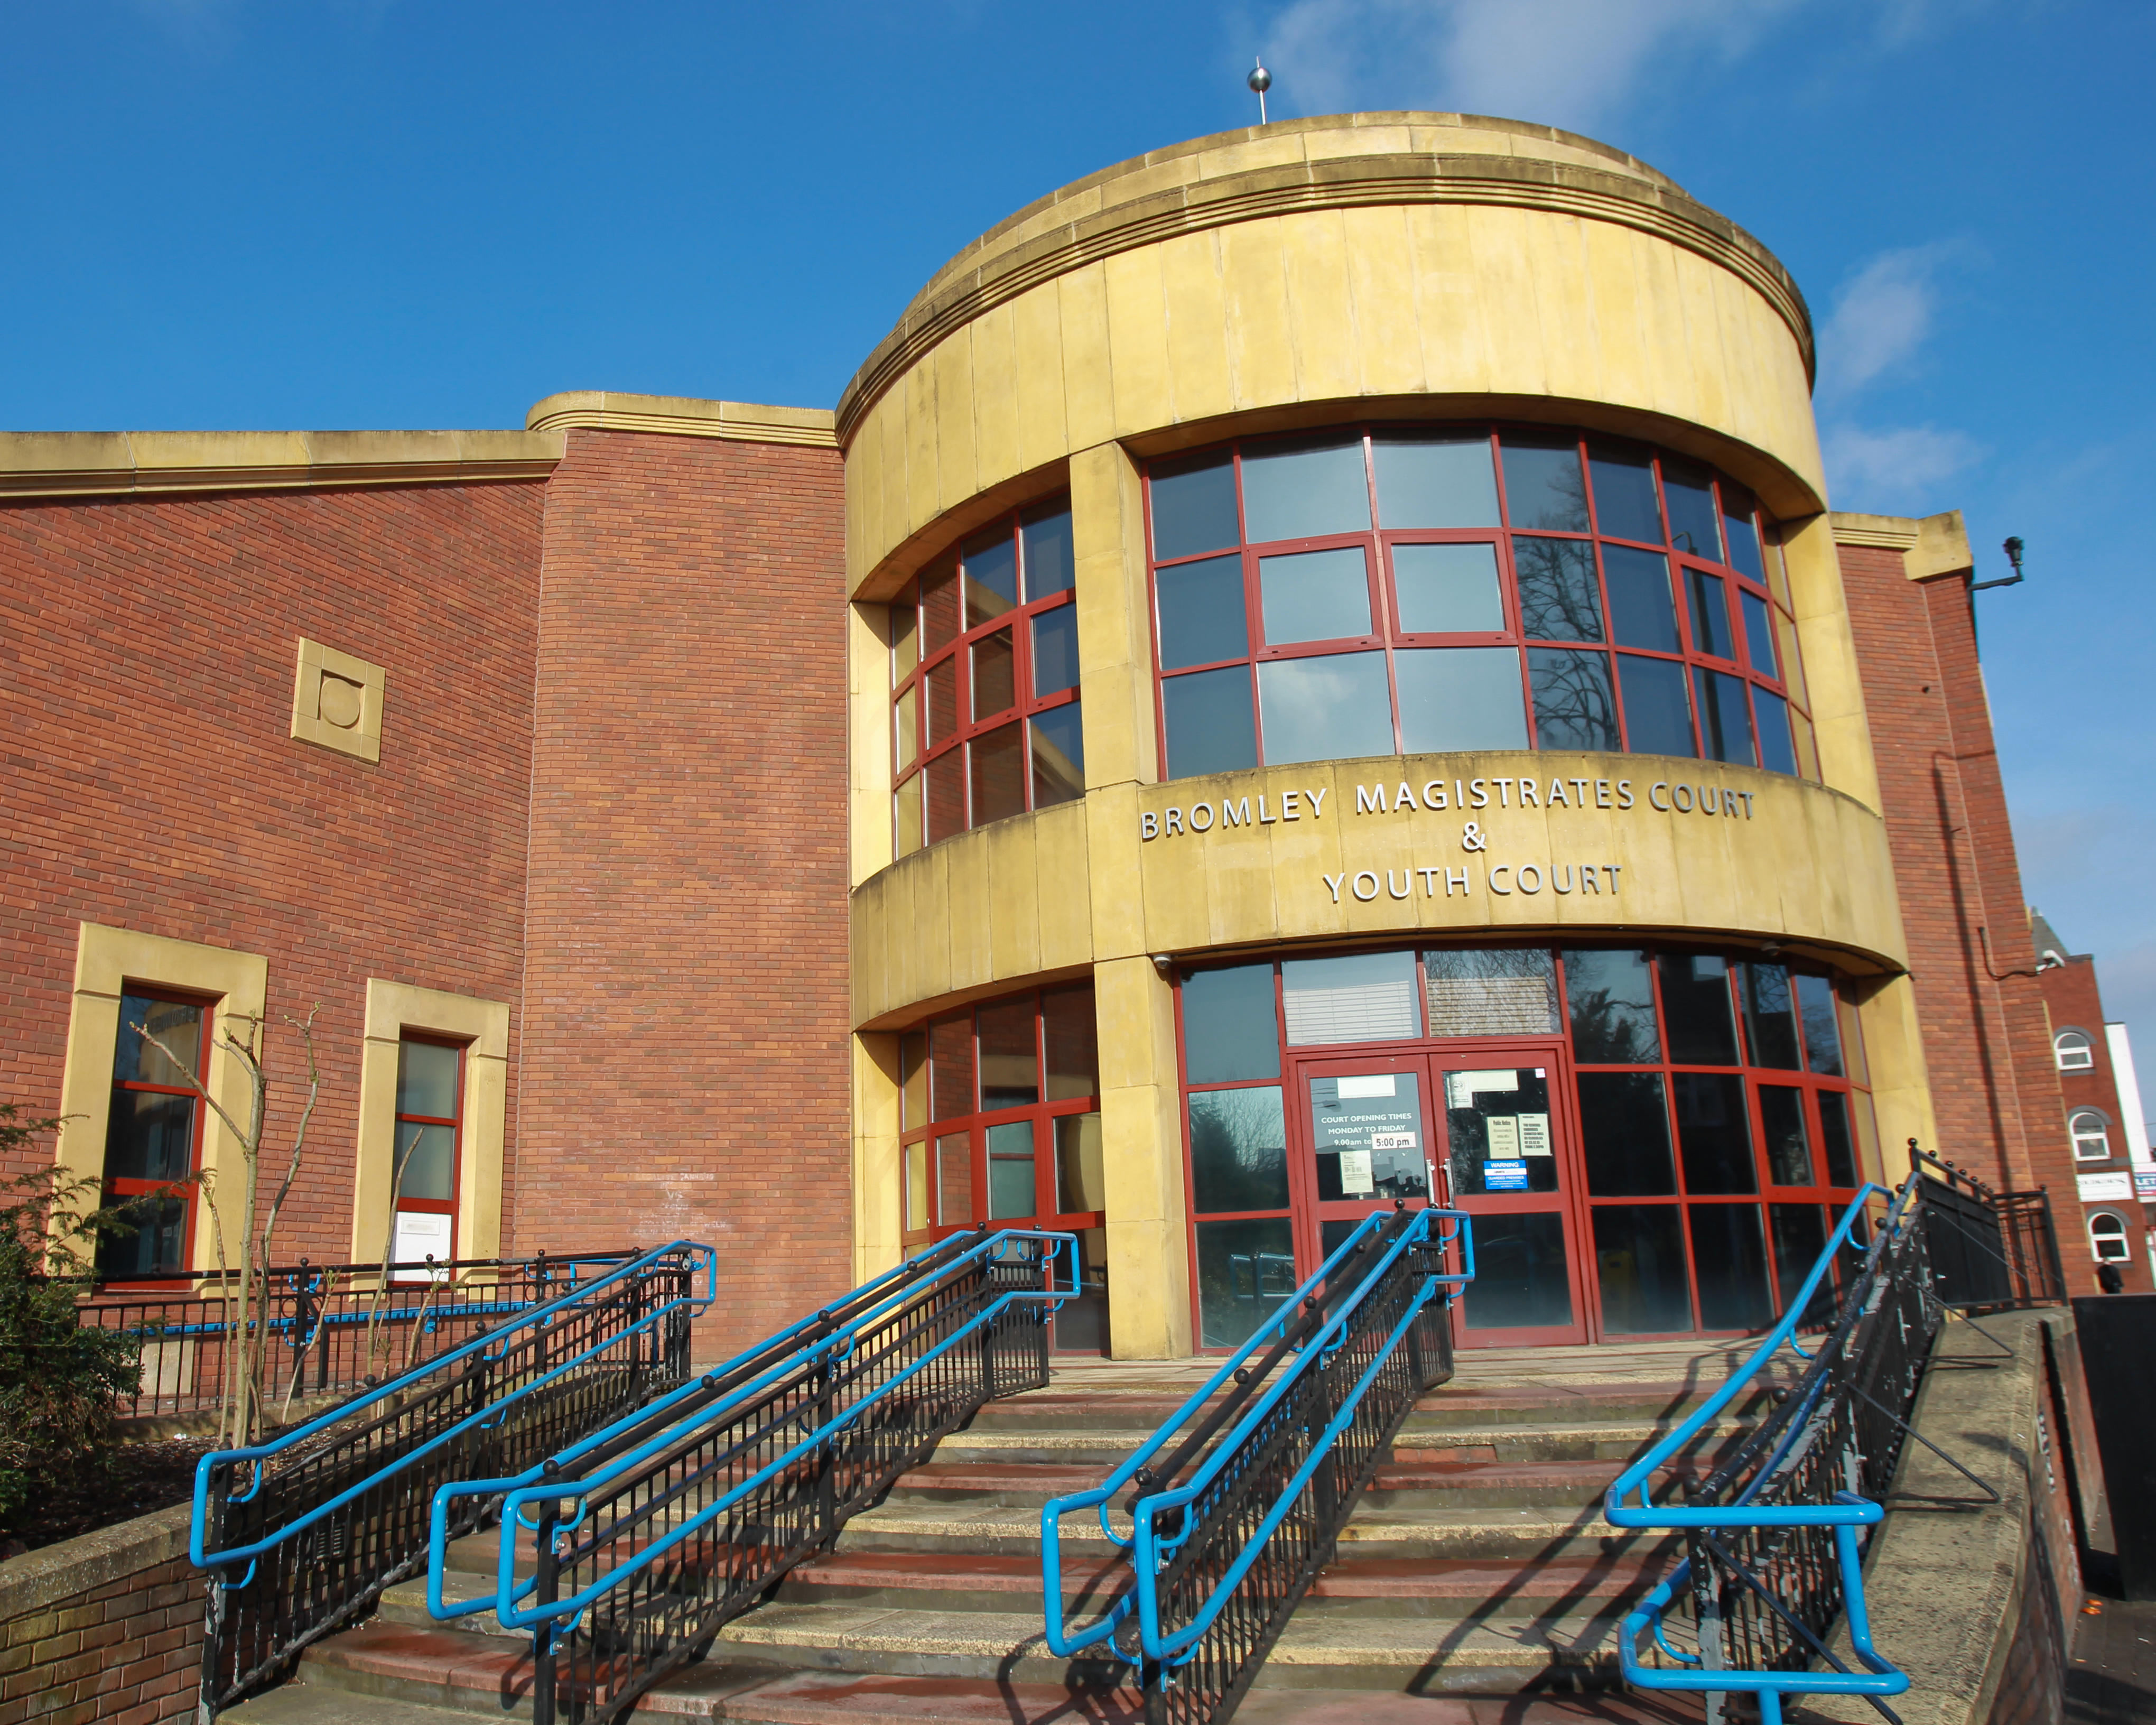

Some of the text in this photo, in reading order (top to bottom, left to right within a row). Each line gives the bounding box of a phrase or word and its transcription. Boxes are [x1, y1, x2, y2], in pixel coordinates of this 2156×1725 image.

[1140, 778, 1755, 841] BROMLEY MAGISTRATES COURT
[1462, 821, 1487, 852] &
[1323, 864, 1623, 902] YOUTH COURT
[1350, 1114, 1387, 1122] OPENING
[1328, 1126, 1363, 1135] MONDAY
[1376, 1137, 1394, 1147] 5:00
[1397, 1138, 1410, 1148] pm
